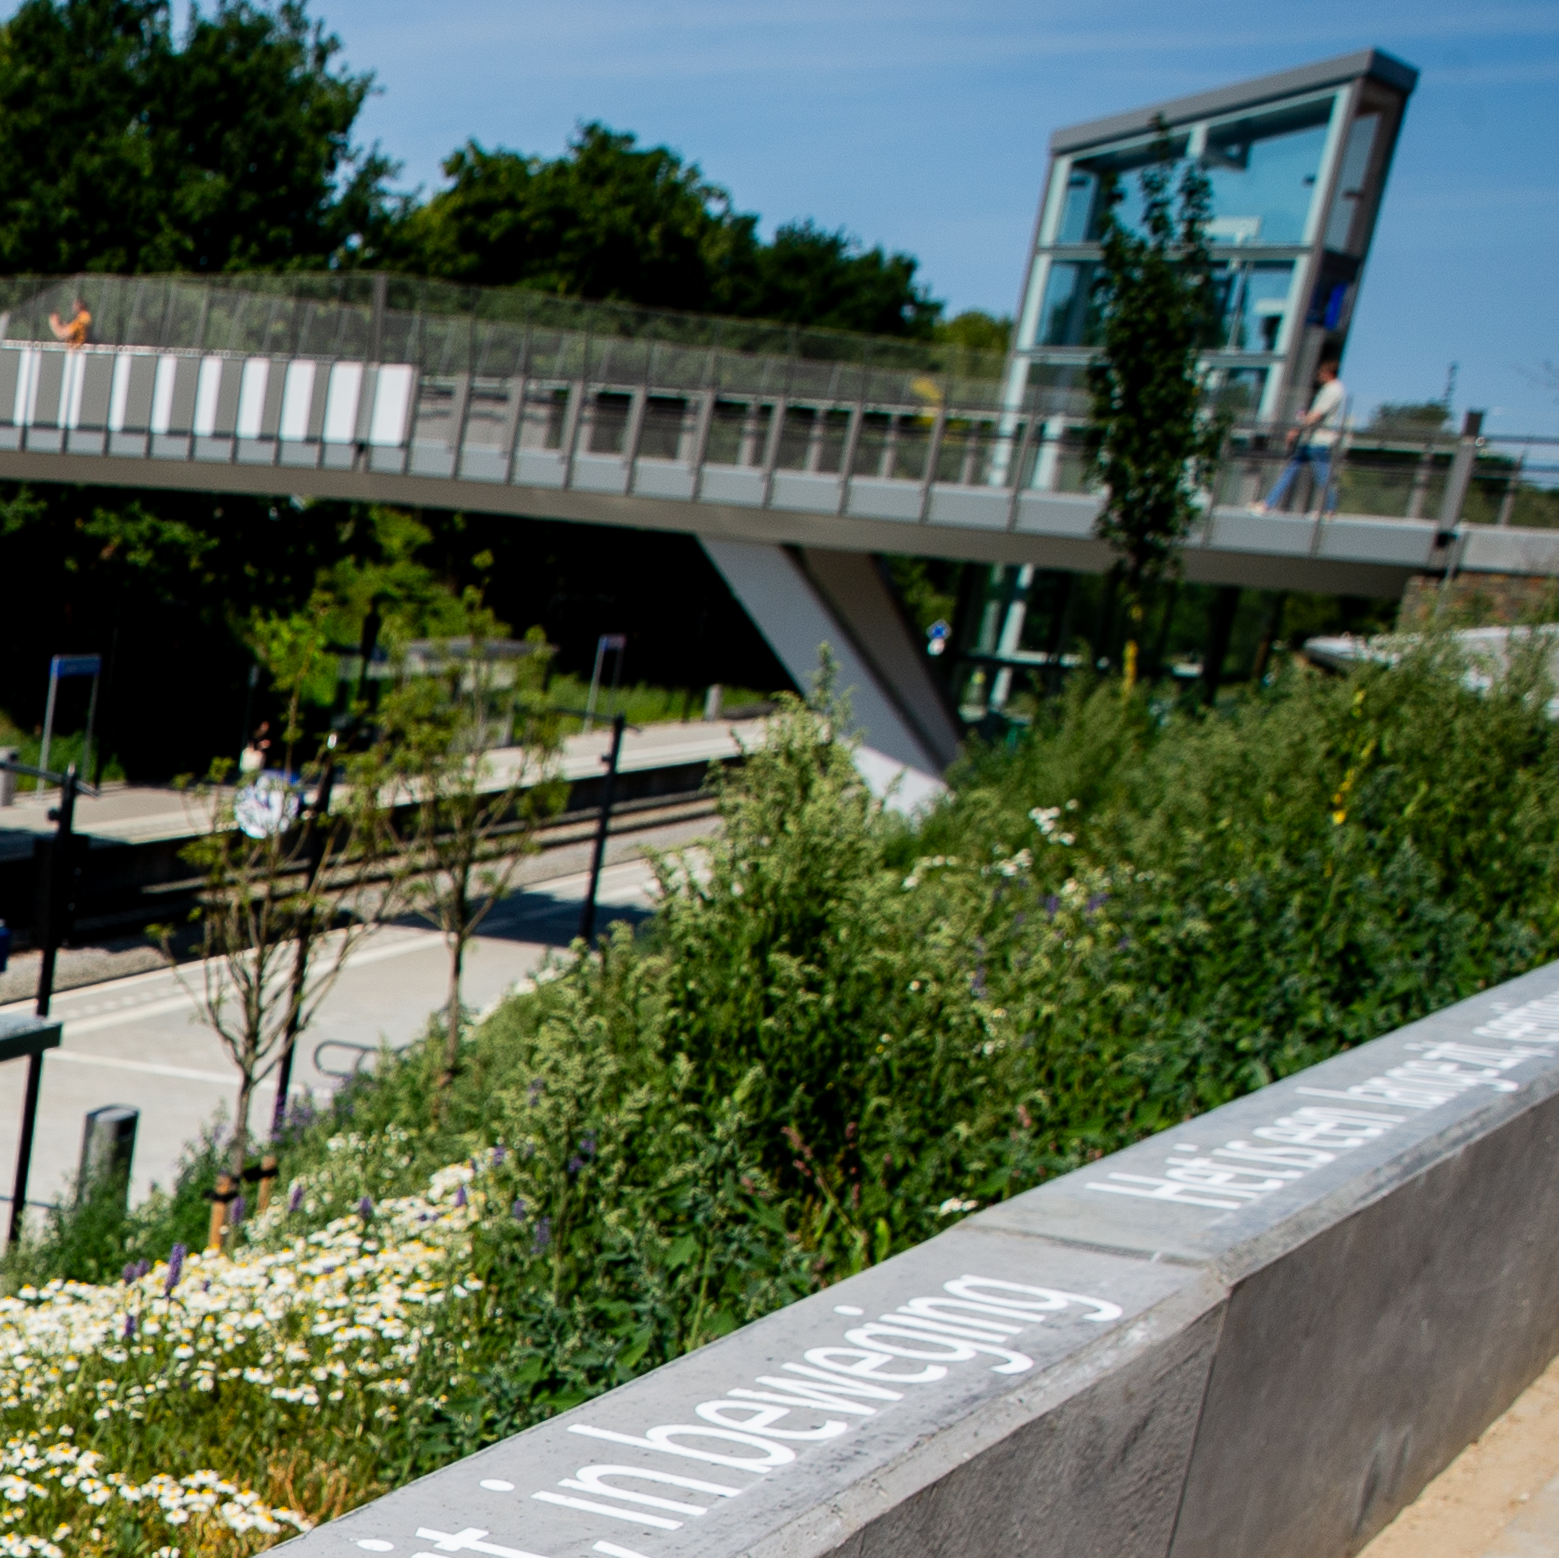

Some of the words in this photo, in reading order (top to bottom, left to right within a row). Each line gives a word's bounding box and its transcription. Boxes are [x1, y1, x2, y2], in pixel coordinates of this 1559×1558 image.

[1174, 1139, 1336, 1169] is
[1252, 1106, 1406, 1148] een
[1086, 1156, 1304, 1210] Het
[568, 1274, 1123, 1474] beweging
[479, 1464, 742, 1530] in
